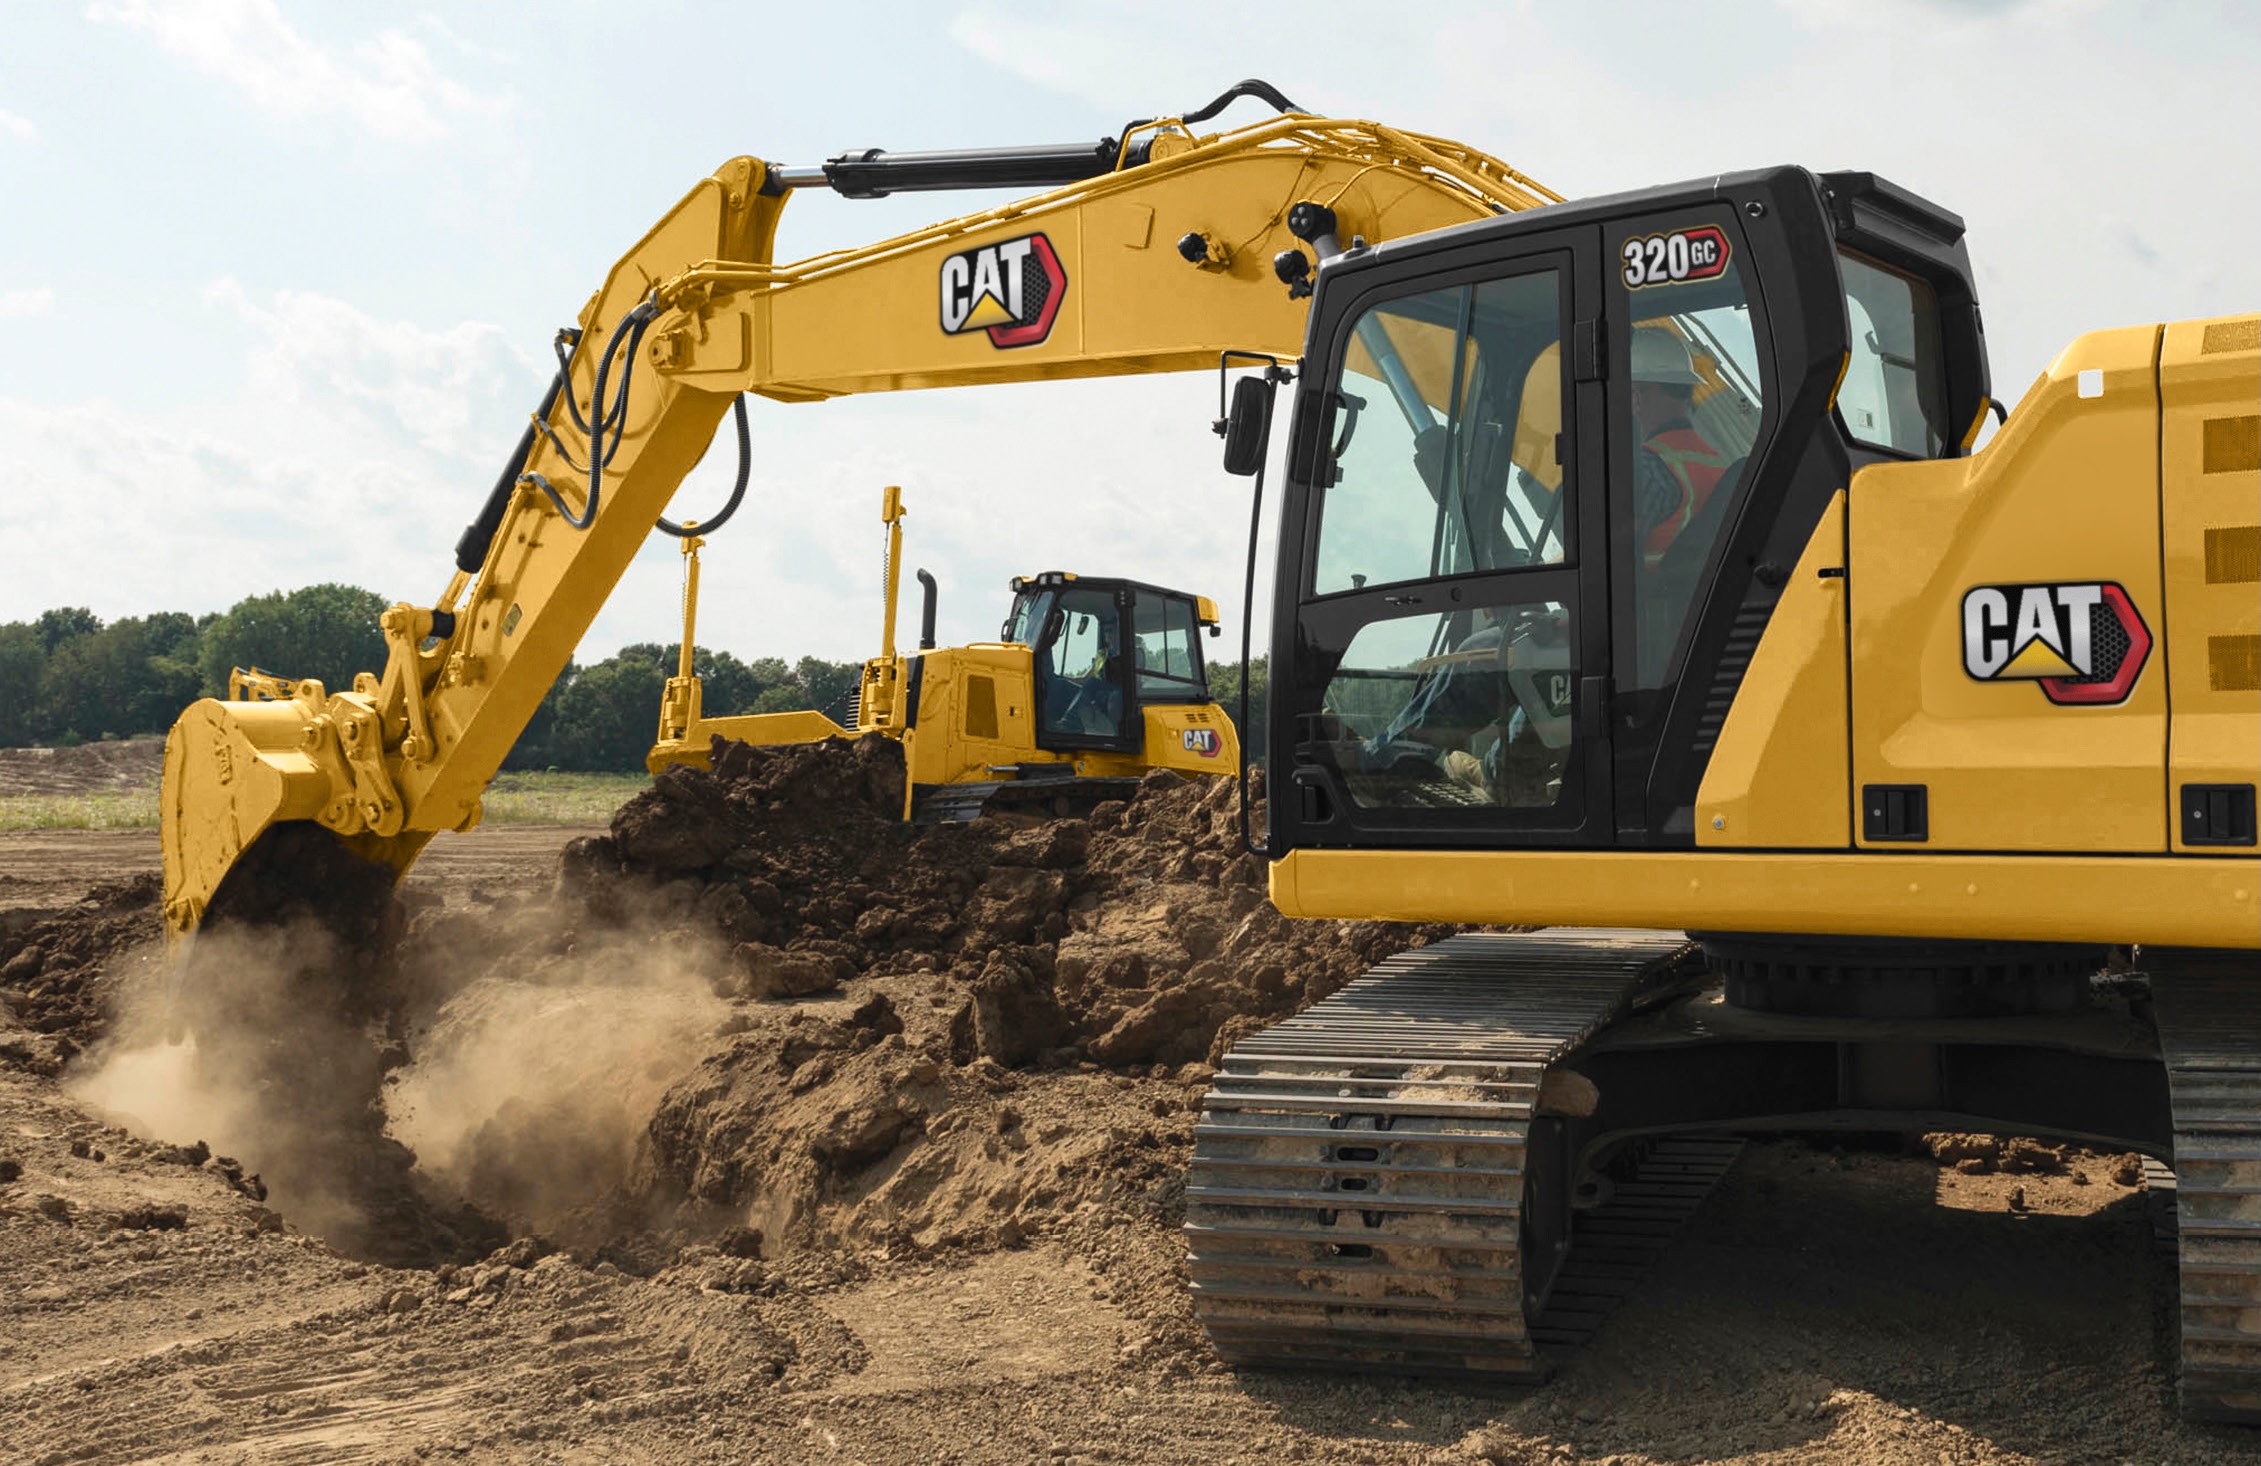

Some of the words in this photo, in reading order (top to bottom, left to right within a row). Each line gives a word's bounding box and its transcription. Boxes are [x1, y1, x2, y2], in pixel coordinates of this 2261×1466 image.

[941, 237, 1031, 333] CAT
[1624, 233, 1689, 286] 320
[1691, 240, 1716, 265] GC
[1964, 585, 2102, 678] CAT
[1183, 730, 1211, 750] CAT
